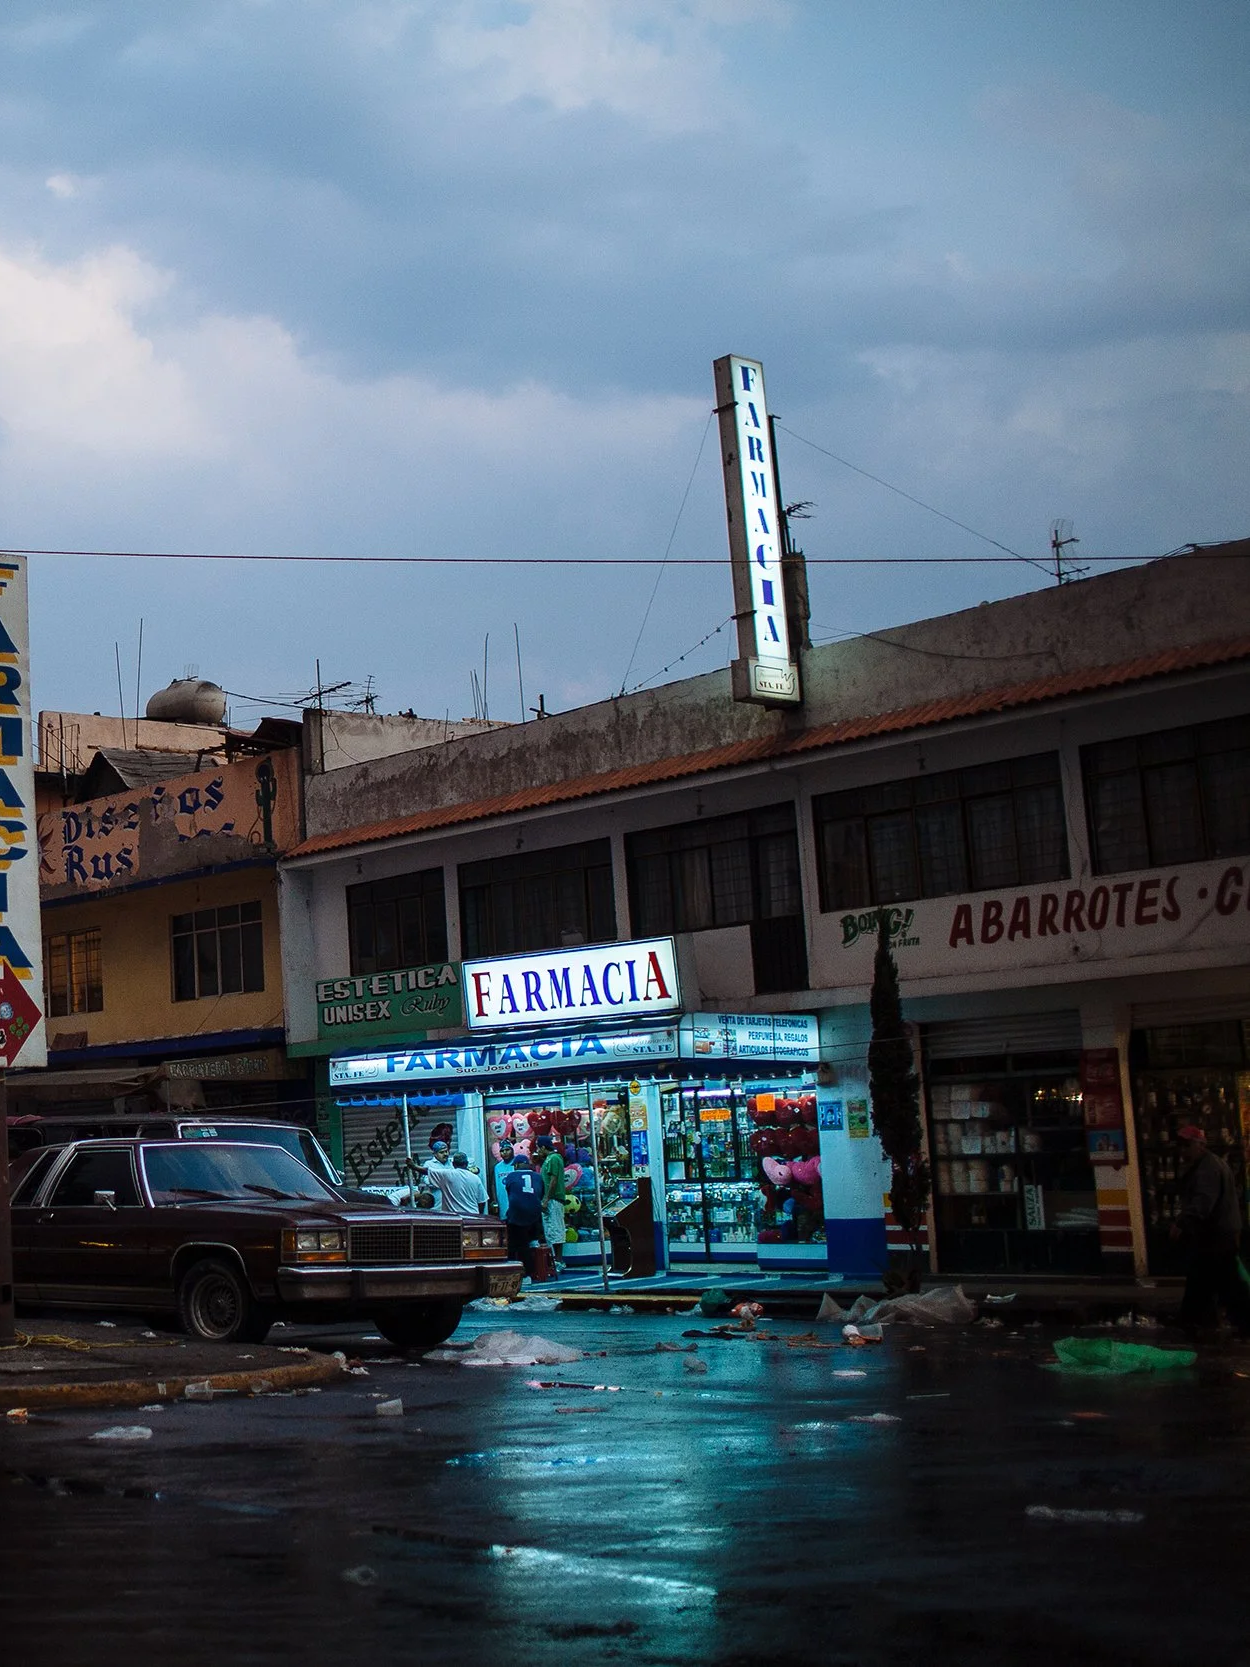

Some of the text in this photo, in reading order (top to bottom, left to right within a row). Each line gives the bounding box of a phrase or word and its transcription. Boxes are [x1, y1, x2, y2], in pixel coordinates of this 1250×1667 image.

[739, 365, 781, 643] FARMACIA
[949, 876, 1181, 948] ABARROTES
[316, 964, 458, 1004] ESTETICA
[471, 951, 672, 1018] FARMACIA
[323, 992, 451, 1026] UNISEX Ruby
[717, 1015, 736, 1025] VENTA
[737, 1015, 744, 1026] DE
[745, 1016, 772, 1027] TARJETAS
[386, 1034, 607, 1073] FARMACIA
[658, 1044, 672, 1052] FE
[784, 1033, 808, 1043] REGALOS
[484, 1063, 512, 1072] José
[515, 1060, 540, 1069] Luis
[521, 1174, 535, 1194] 1
